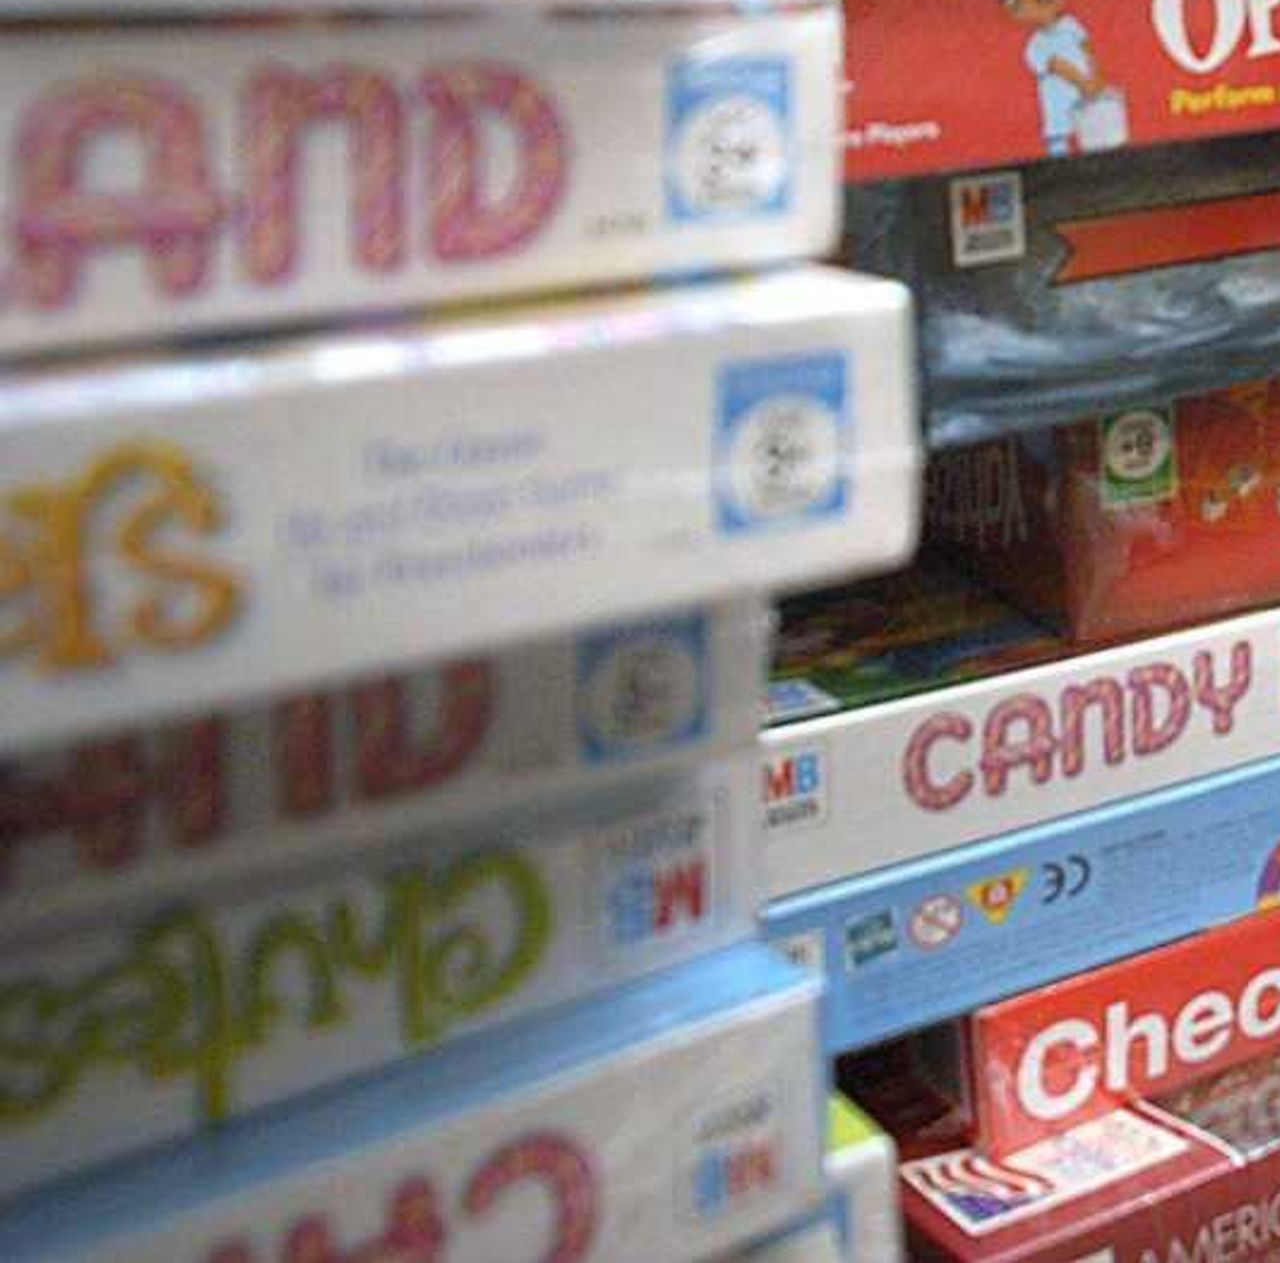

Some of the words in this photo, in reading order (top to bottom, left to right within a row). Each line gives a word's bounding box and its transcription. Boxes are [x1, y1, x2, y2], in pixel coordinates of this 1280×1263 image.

[1169, 83, 1276, 115] Perform
[903, 640, 1253, 812] CANDY
[763, 754, 821, 802] MB
